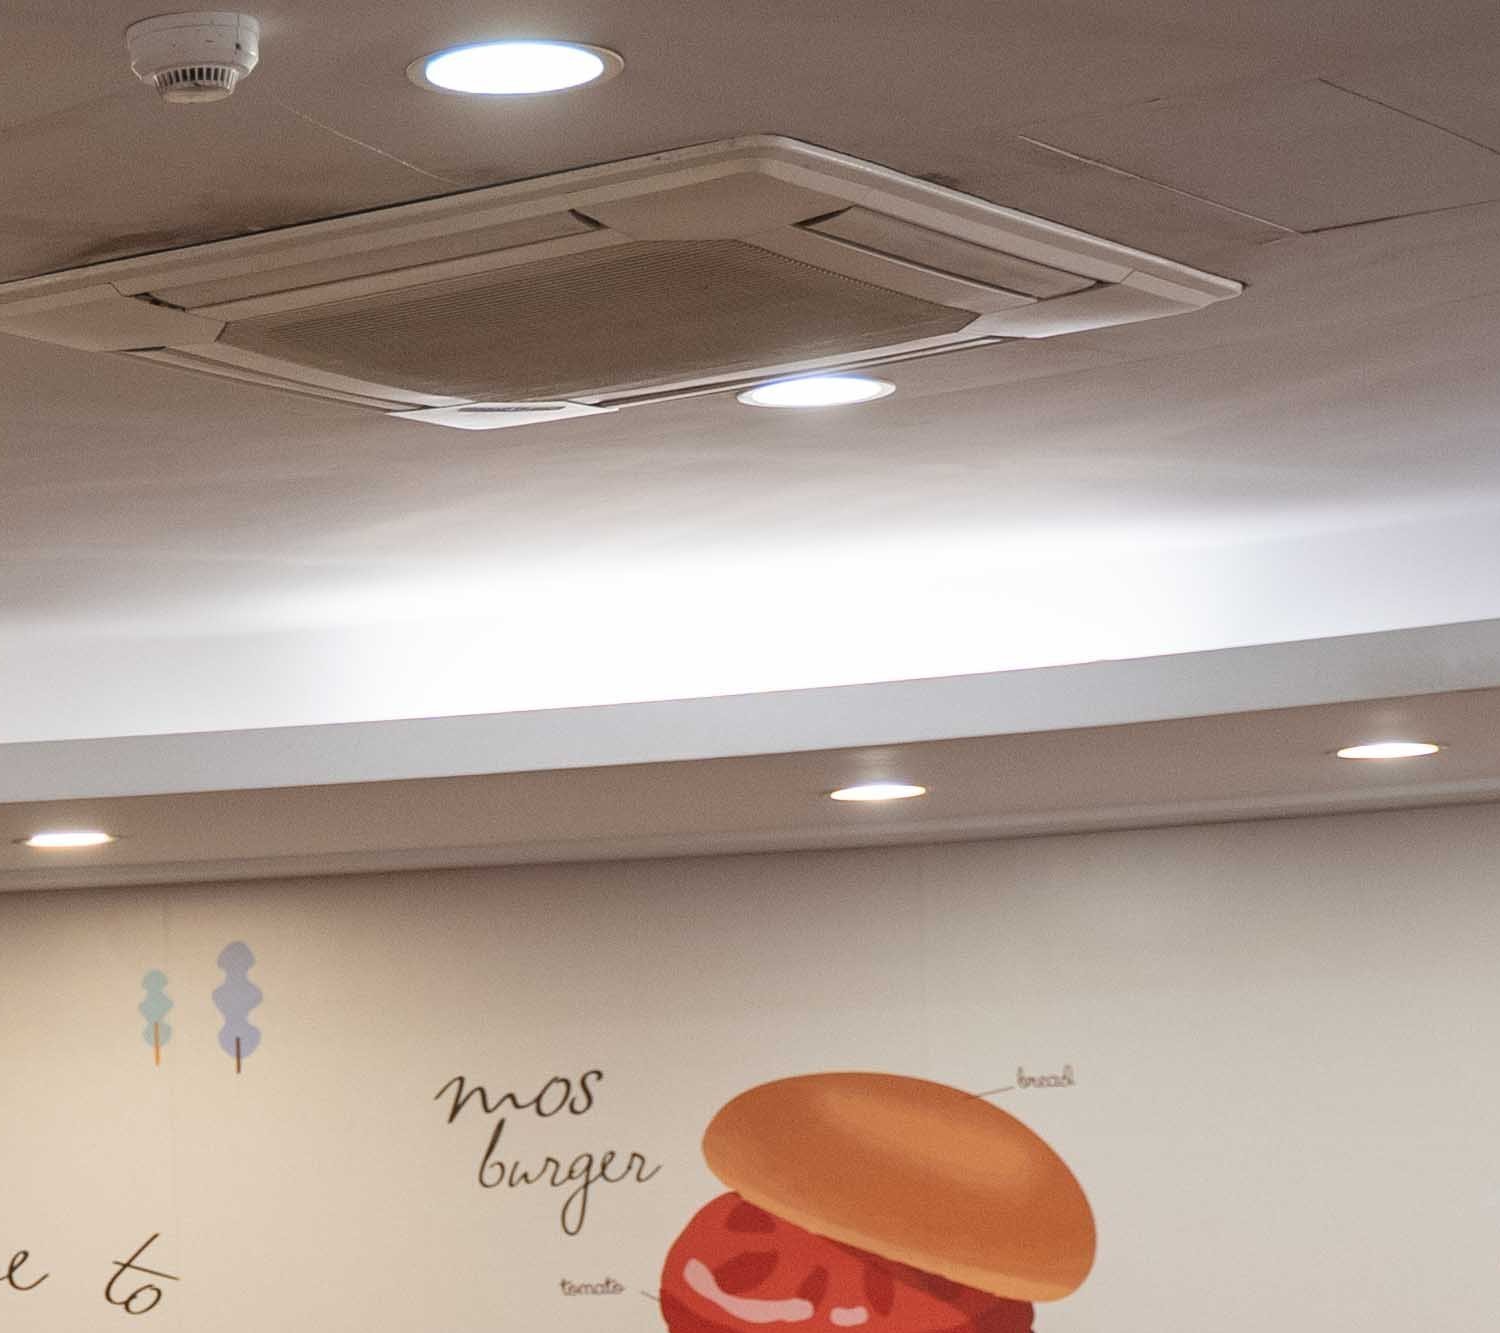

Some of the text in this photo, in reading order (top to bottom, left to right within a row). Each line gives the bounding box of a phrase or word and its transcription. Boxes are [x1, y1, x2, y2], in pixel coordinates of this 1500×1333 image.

[1016, 1065, 1075, 1088] bread
[478, 1119, 662, 1236] burger
[104, 1233, 181, 1316] to
[559, 1277, 625, 1296] tomato
